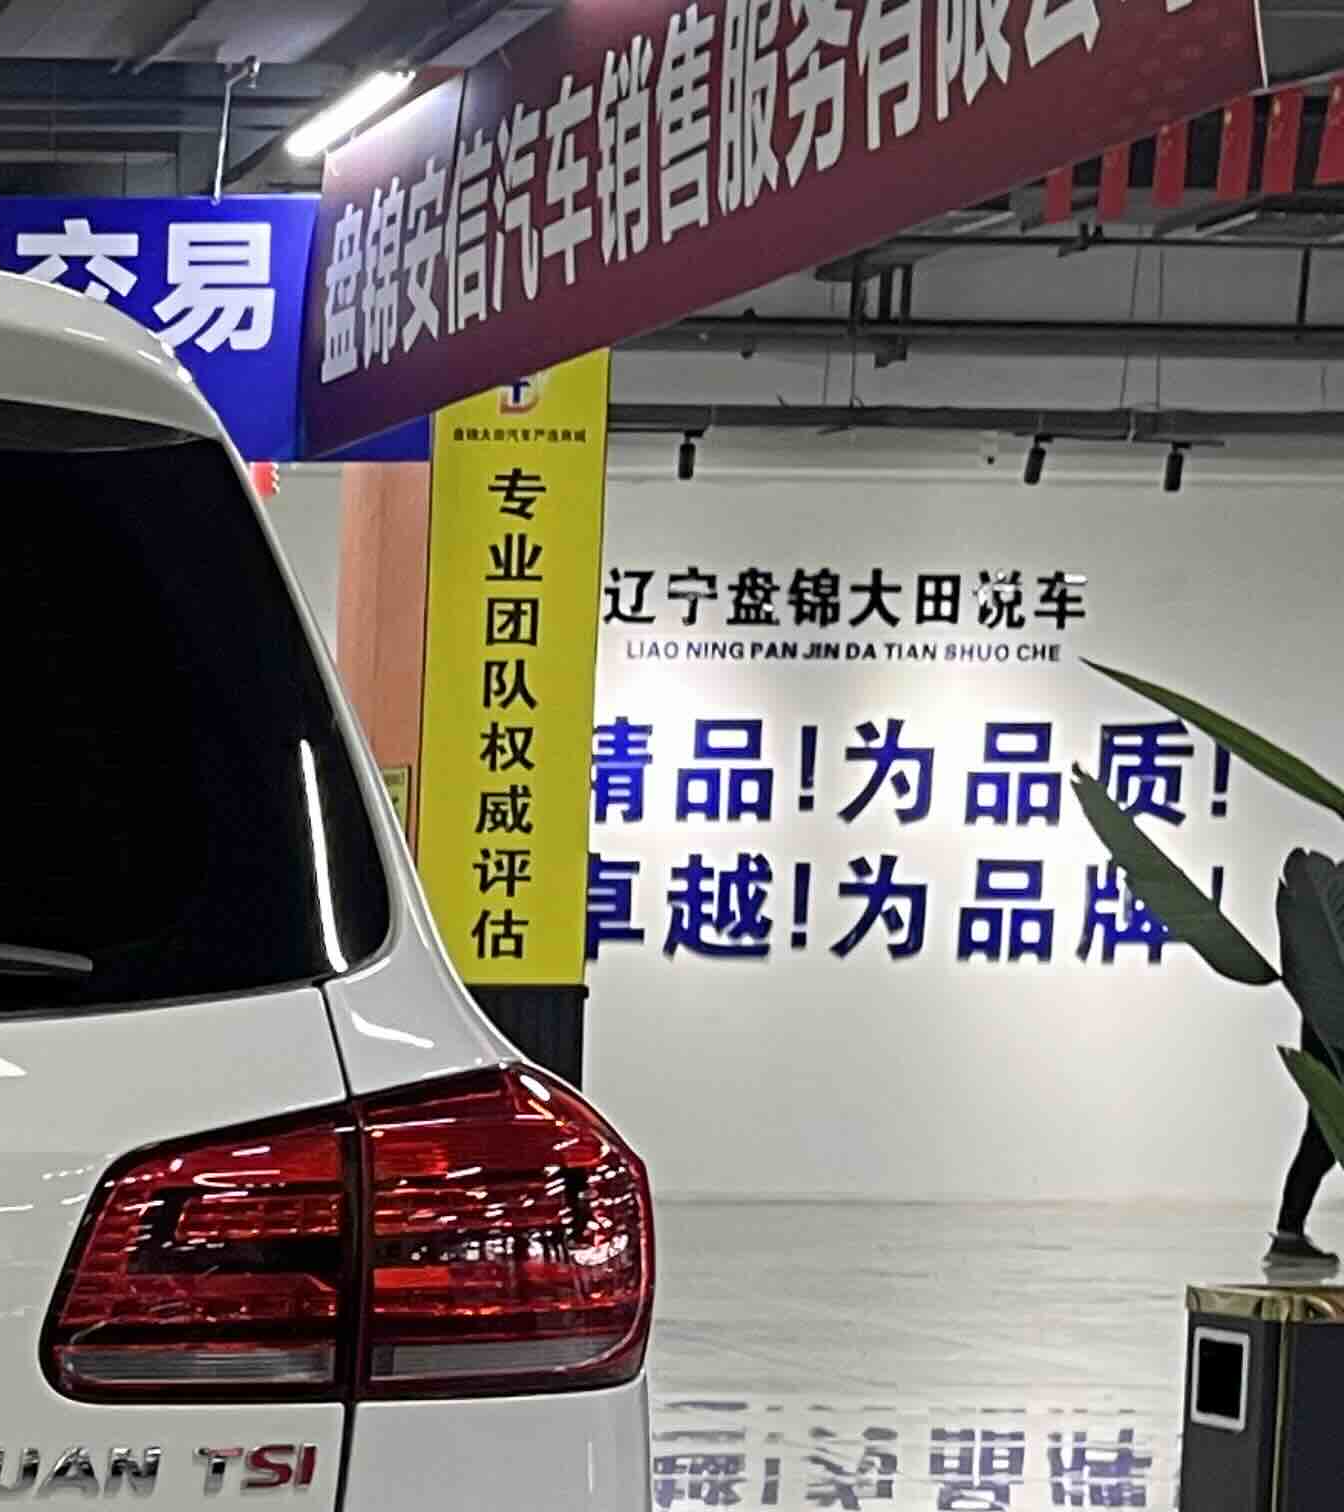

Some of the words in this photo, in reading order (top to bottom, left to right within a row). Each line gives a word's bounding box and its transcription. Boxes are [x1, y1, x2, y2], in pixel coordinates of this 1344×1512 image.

[320, 0, 1197, 384] 盘锦安信汽车销售服务有限
[603, 567, 1088, 630] 辽宁盘锦大田说车
[625, 640, 679, 660] LIAO
[686, 640, 745, 660] NING
[749, 641, 799, 660] PAN
[802, 642, 841, 660] JIN
[845, 642, 877, 661] DA
[884, 642, 937, 661] TIAN
[944, 643, 1010, 662] SHUO
[1016, 644, 1061, 663] CHE
[470, 467, 547, 959] 专业团队权威评估
[194, 1443, 319, 1497] TSI
